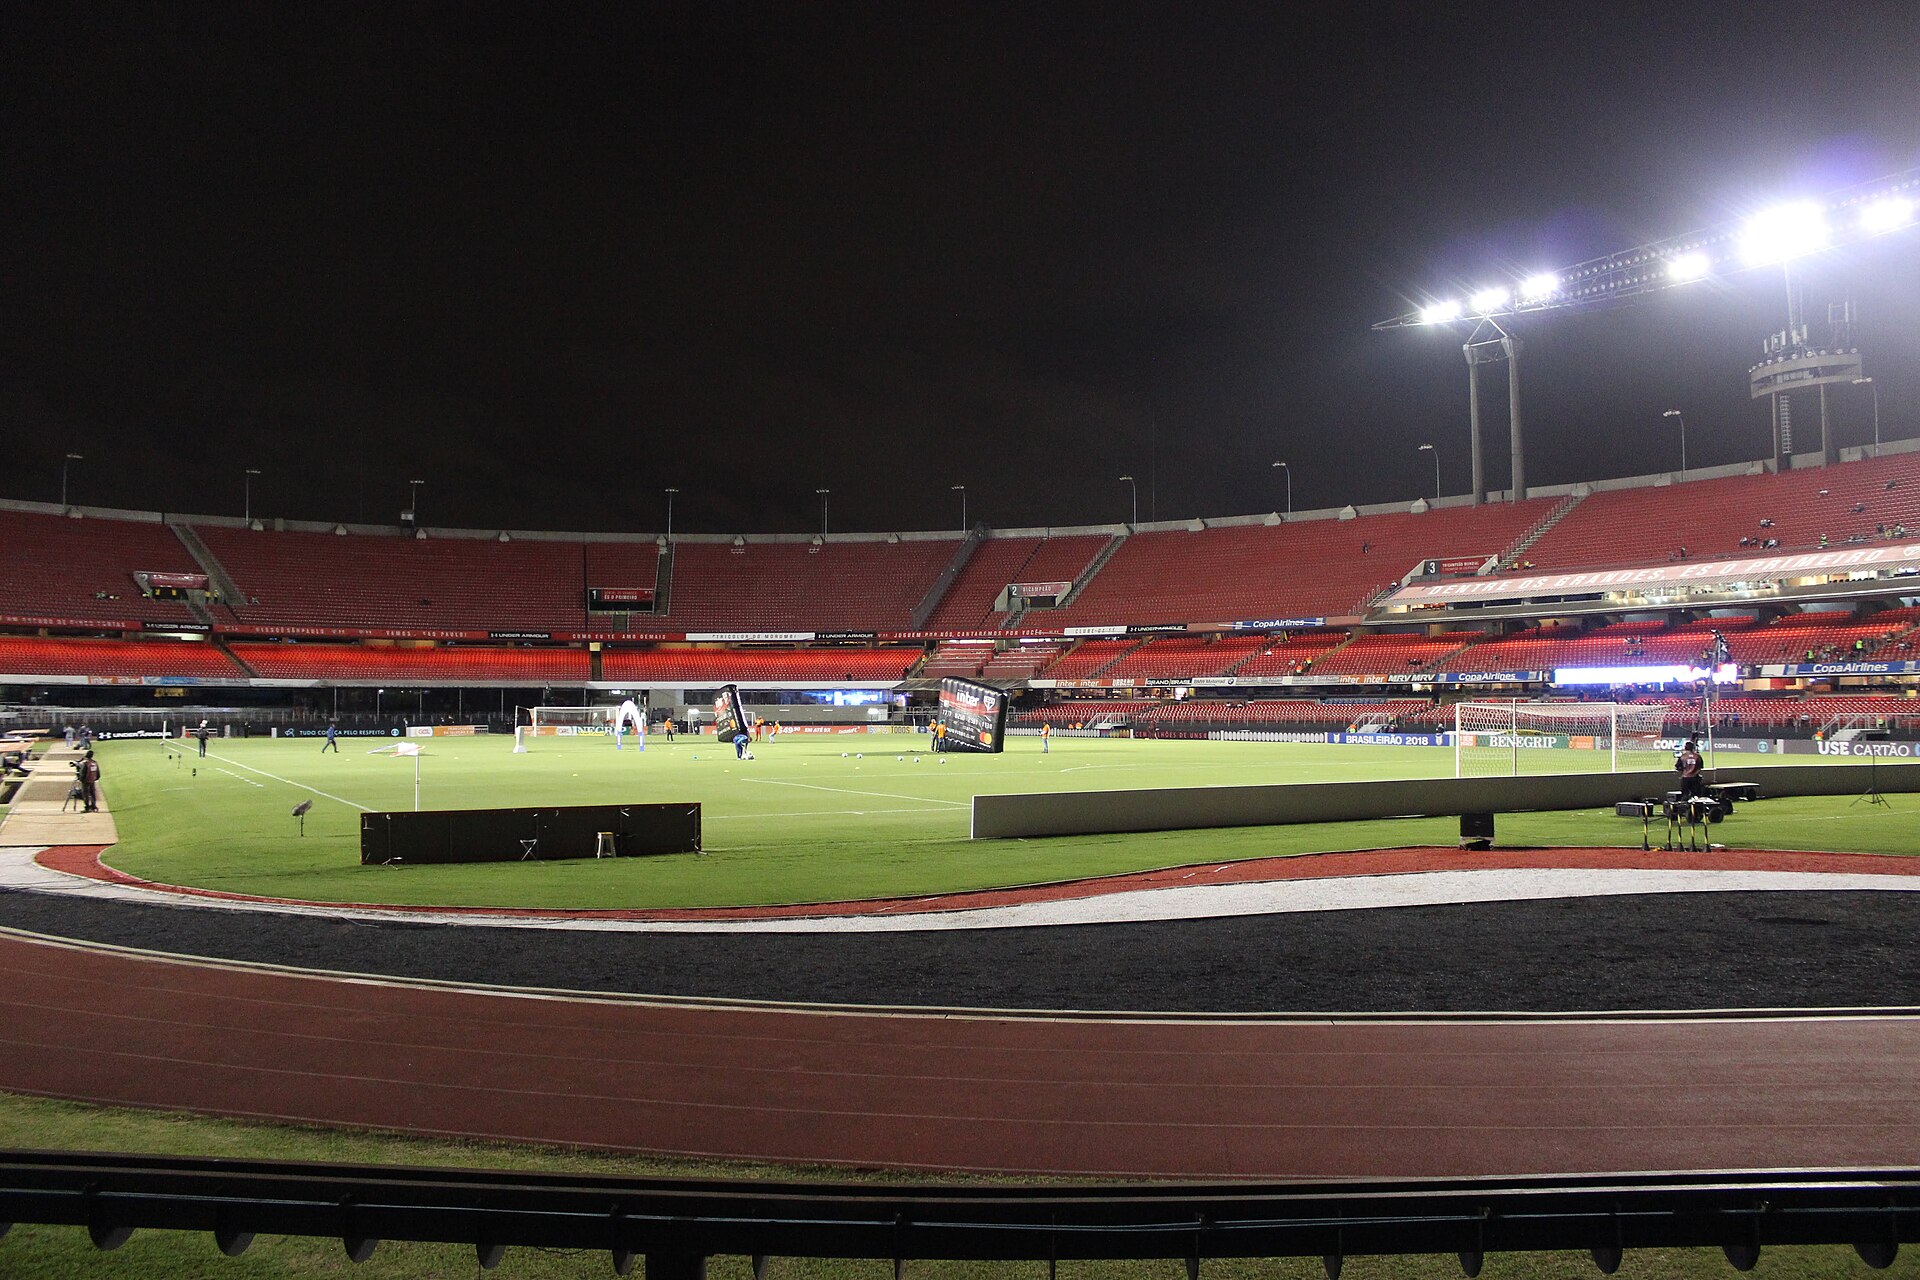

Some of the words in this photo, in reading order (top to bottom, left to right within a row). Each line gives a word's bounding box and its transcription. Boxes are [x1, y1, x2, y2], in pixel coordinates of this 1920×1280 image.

[1428, 581, 1513, 595] DENTRE
[1517, 577, 1549, 590] OS
[1719, 563, 1737, 575] O
[1745, 549, 1885, 573] PRIMEIRO
[1429, 561, 1436, 574] 3
[1011, 585, 1018, 596] 2
[1056, 679, 1077, 687] inter
[1080, 679, 1100, 687] inter
[1339, 675, 1360, 683] inter
[1363, 675, 1386, 683] inter
[1388, 674, 1412, 683] MRV
[1411, 673, 1435, 682] MRV
[956, 691, 980, 707] inter
[1345, 734, 1403, 745] BRASILEIRÃO
[1405, 736, 1429, 746] 2018
[1489, 735, 1558, 749] BENEGRIP
[1714, 742, 1727, 750] COM
[1817, 741, 1850, 756] USE
[1853, 742, 1910, 757] CARTÃO
